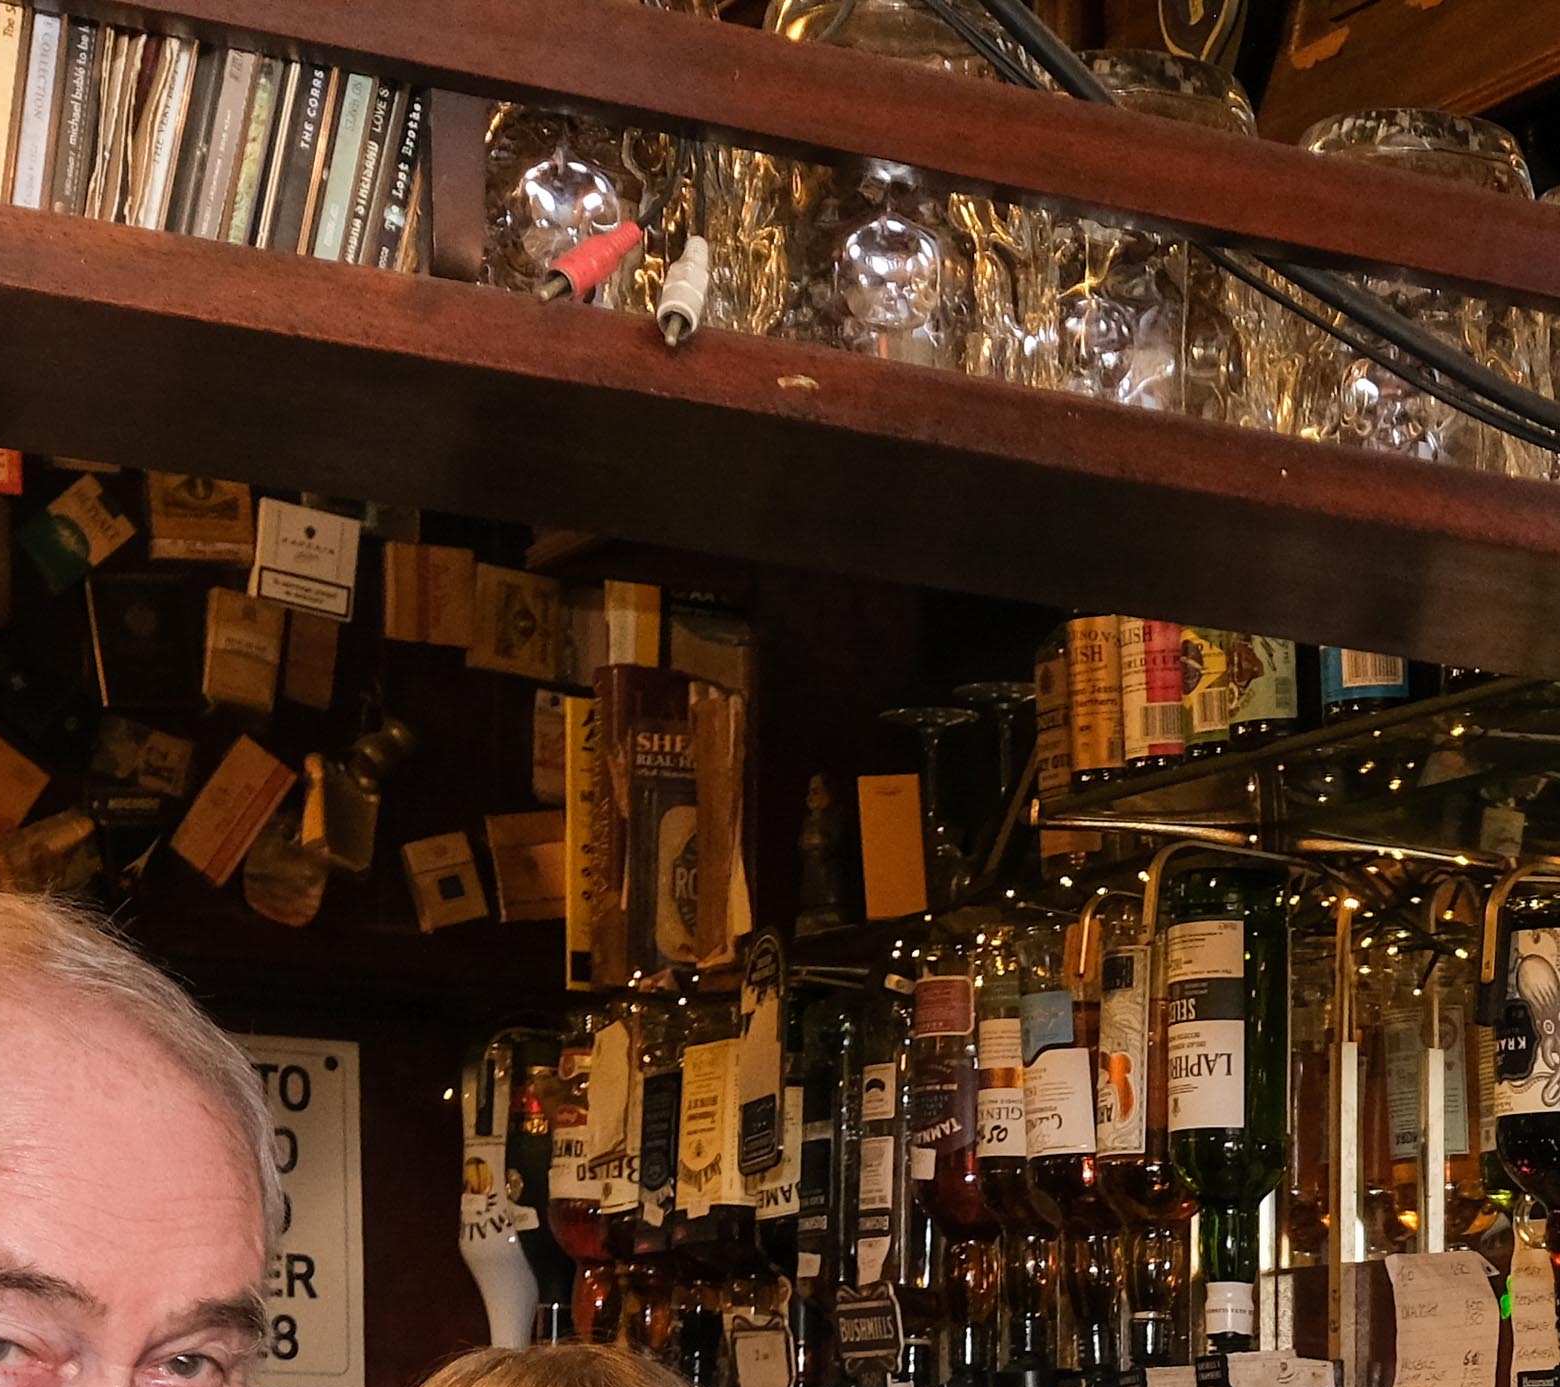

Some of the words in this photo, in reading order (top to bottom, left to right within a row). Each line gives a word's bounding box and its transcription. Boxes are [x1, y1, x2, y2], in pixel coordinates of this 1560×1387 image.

[66, 95, 82, 147] michael
[299, 121, 315, 150] THE
[308, 68, 325, 119] CORRS
[371, 99, 389, 134] LOVE
[391, 161, 411, 200] Lost
[635, 731, 689, 752] SHE
[839, 1315, 894, 1343] BUSHMILLS
